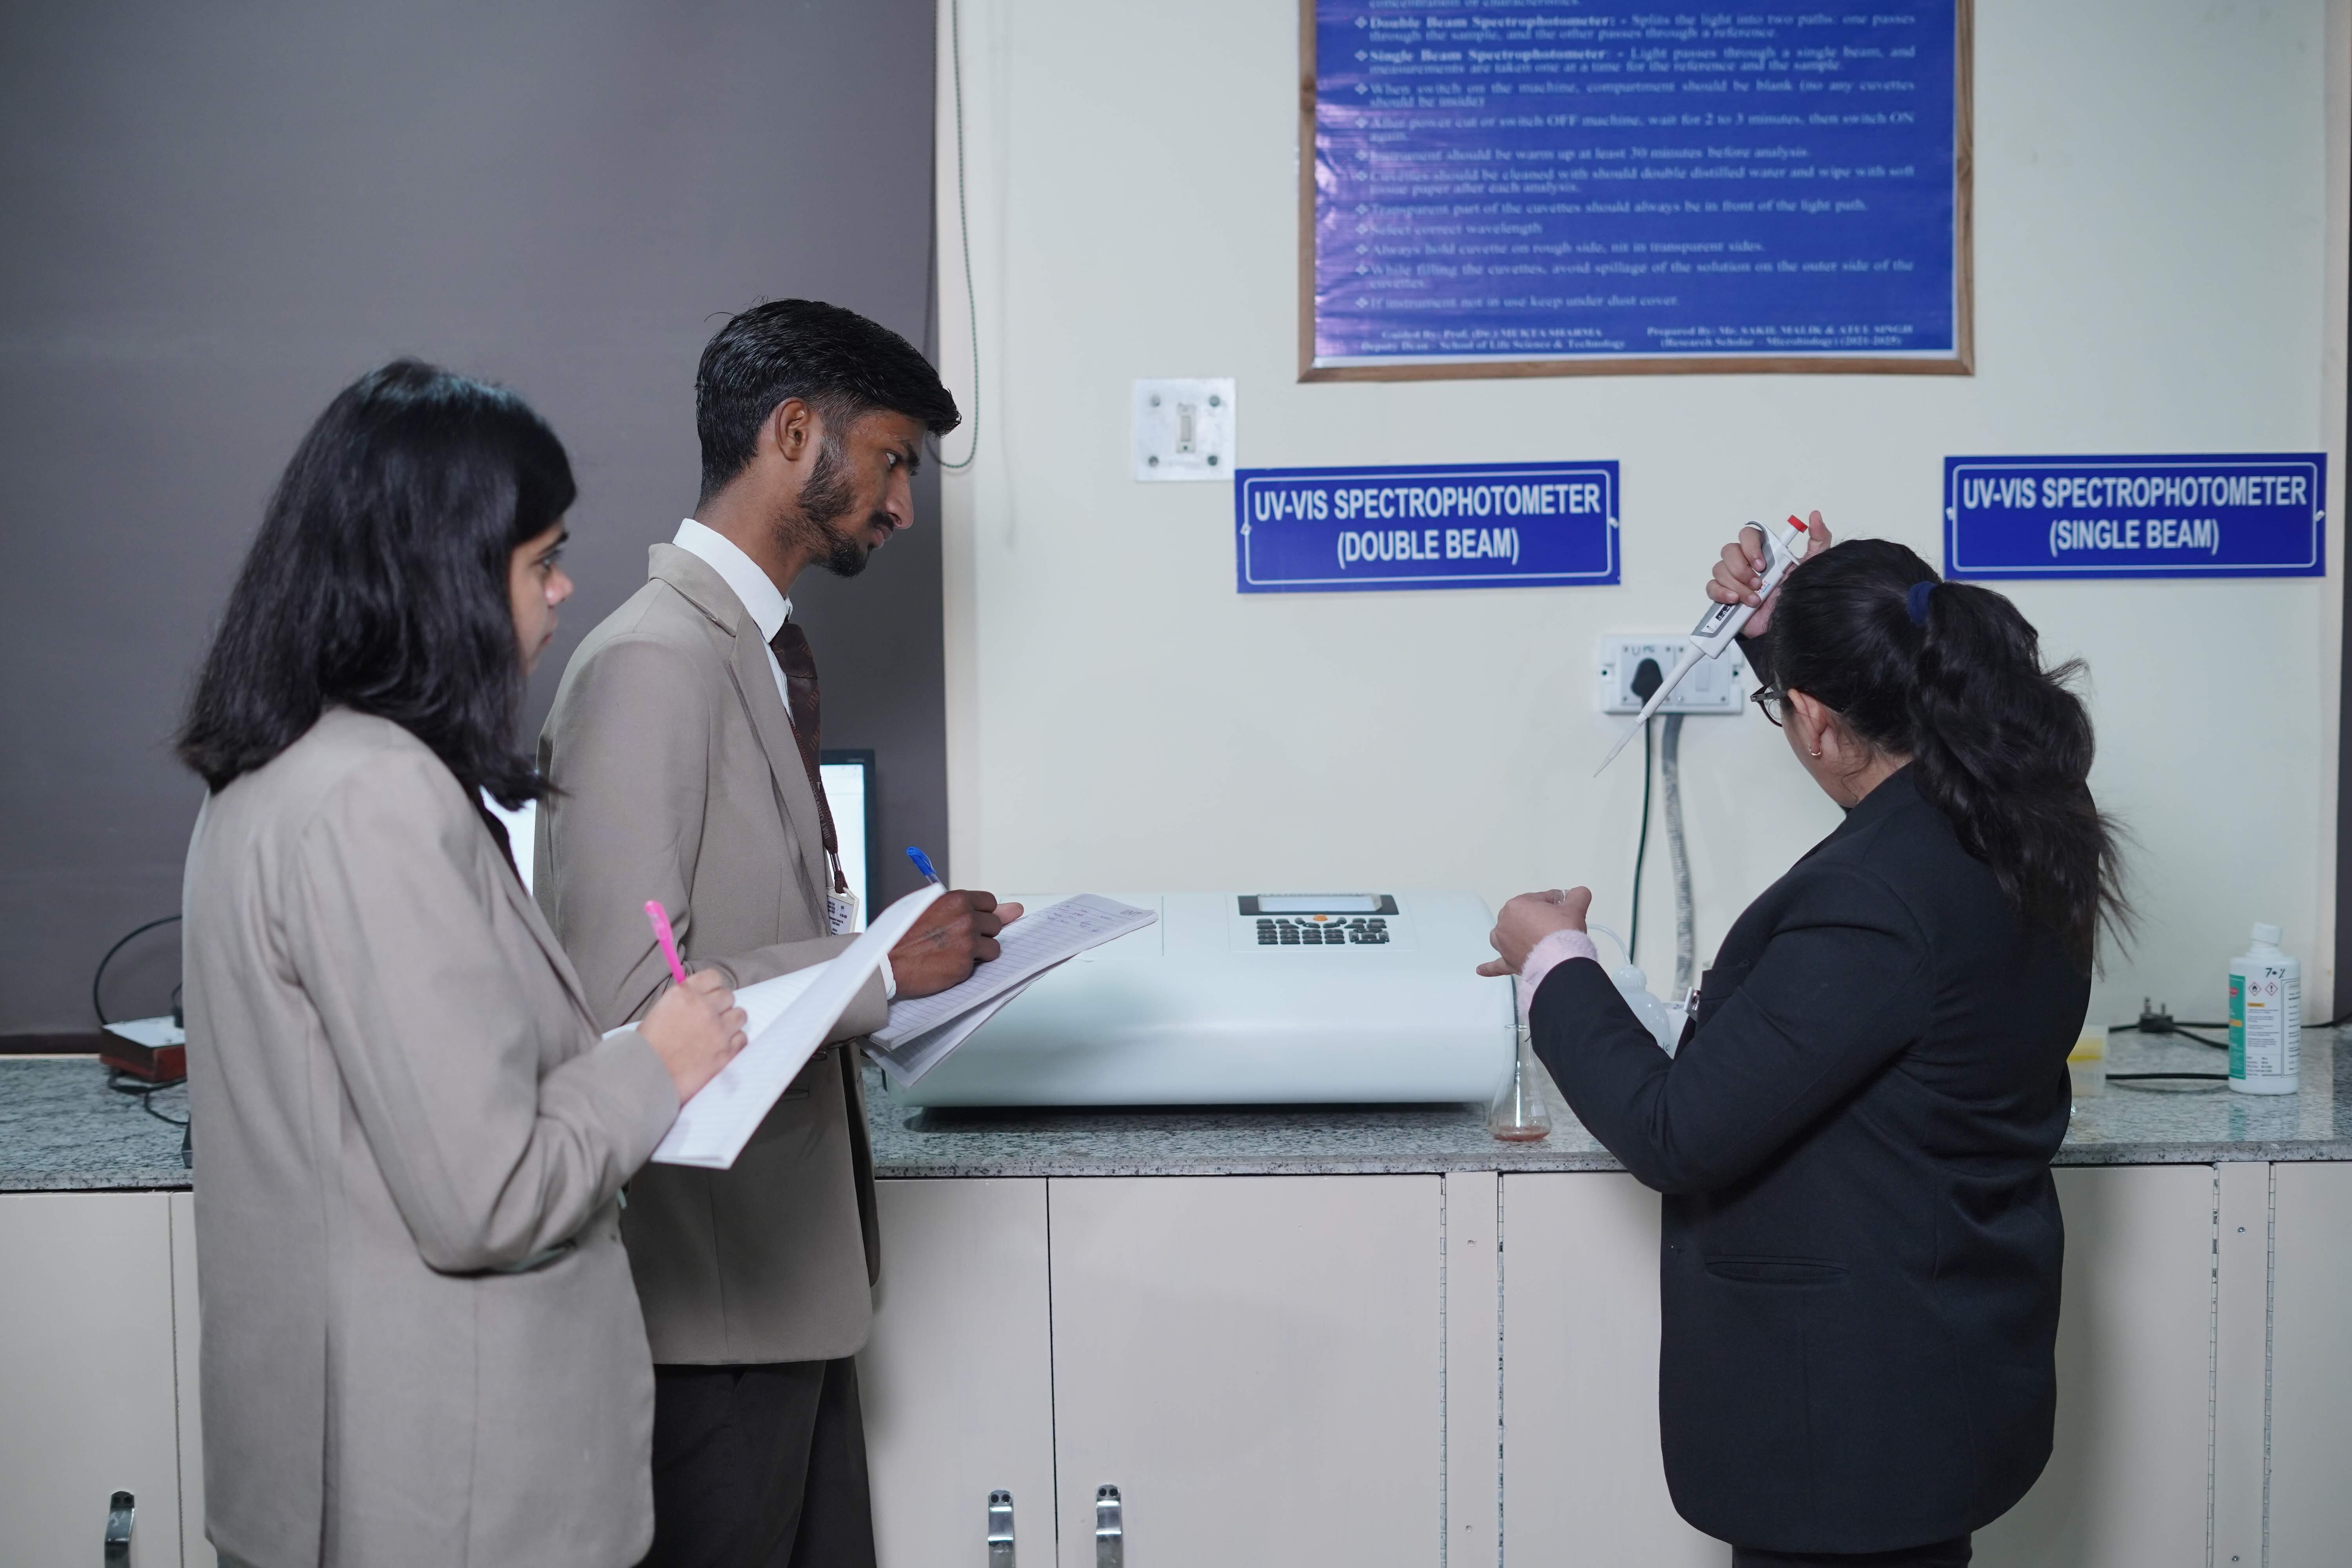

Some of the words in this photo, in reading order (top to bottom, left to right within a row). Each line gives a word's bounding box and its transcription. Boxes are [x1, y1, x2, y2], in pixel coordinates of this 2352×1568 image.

[1255, 489, 1328, 521] UV-VIS
[1334, 483, 1601, 519] SPECTROPHOTOMETER
[1964, 477, 2037, 509] UV-VIS
[2042, 475, 2307, 508] SPECTROPHOTOMETER
[1337, 530, 1439, 569] (DOUBLE
[1446, 527, 1519, 565] BEAM)
[2050, 519, 2140, 557] (SINGLE
[2146, 518, 2219, 555] BEAM)
